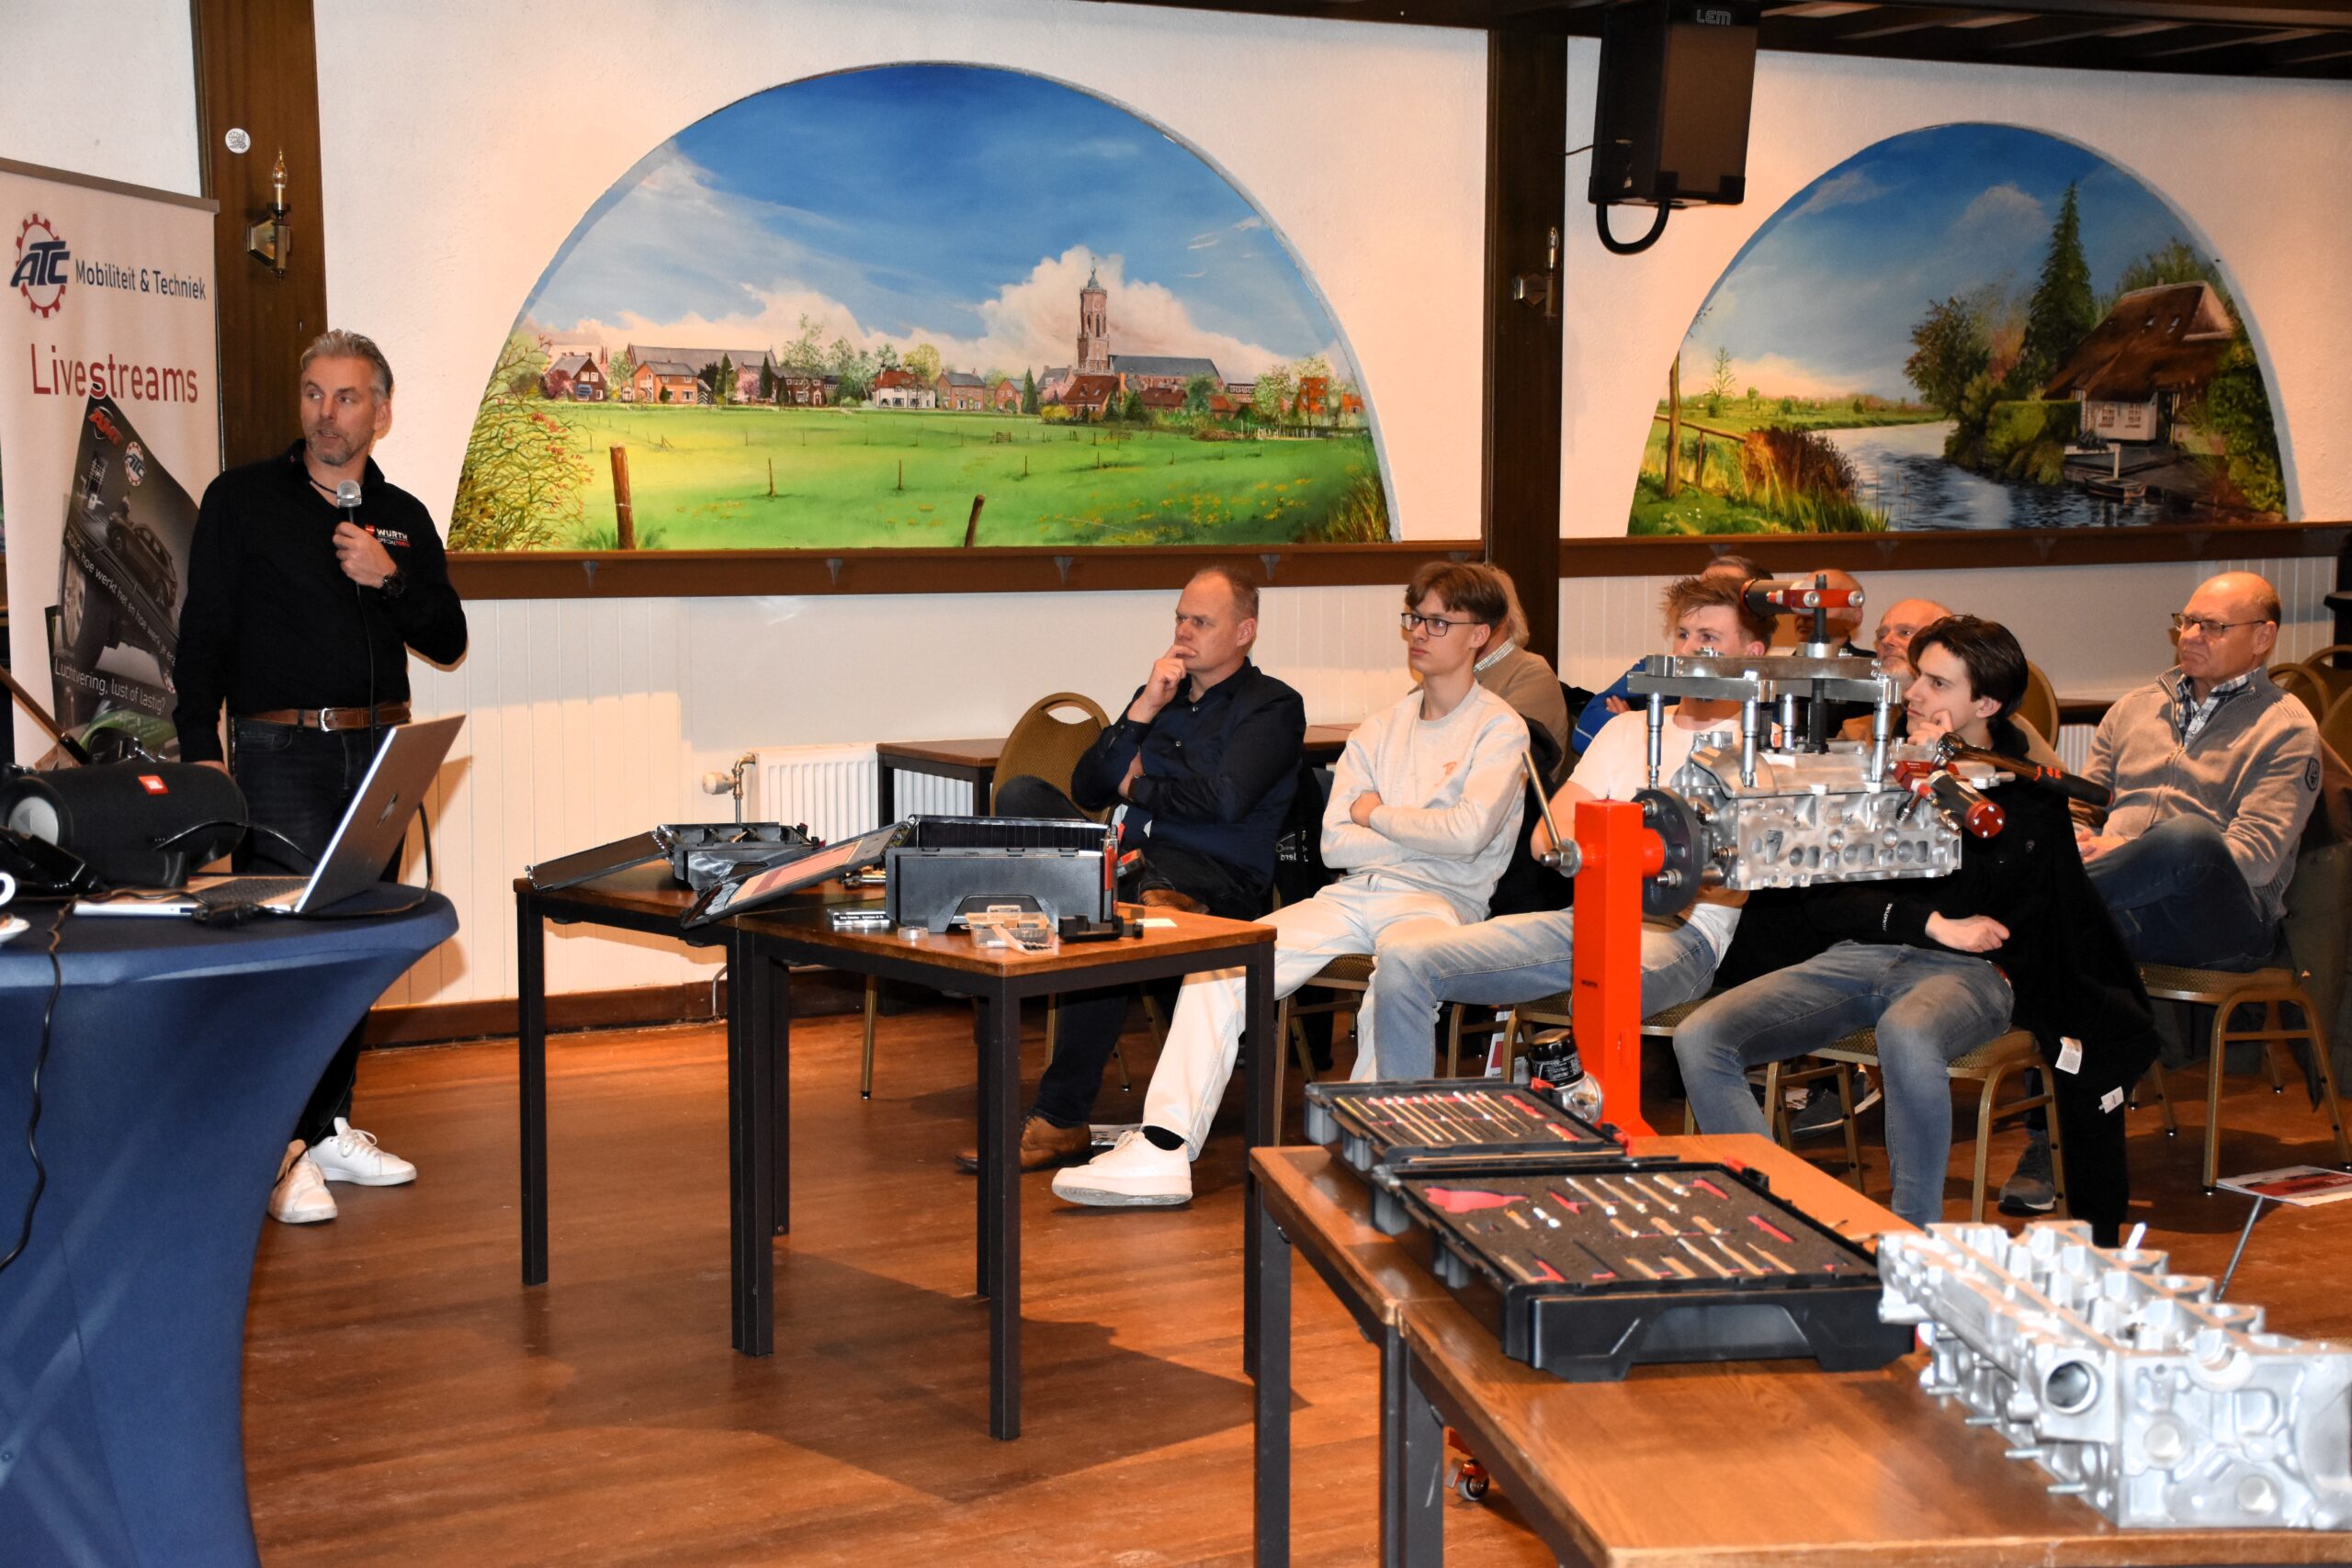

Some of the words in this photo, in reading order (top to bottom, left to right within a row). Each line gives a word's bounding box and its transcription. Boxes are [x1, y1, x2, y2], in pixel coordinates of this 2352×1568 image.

[10, 241, 71, 288] ATC
[75, 259, 136, 291] Mobiliteit
[140, 268, 150, 293] &
[153, 270, 207, 299] Techniek
[31, 344, 198, 403] Livestreams
[82, 553, 94, 573] hoe
[96, 568, 118, 594] werkt
[55, 657, 108, 696] Luchtvering,
[111, 678, 129, 700] lust
[130, 686, 139, 704] of
[140, 691, 166, 715] lastig?
